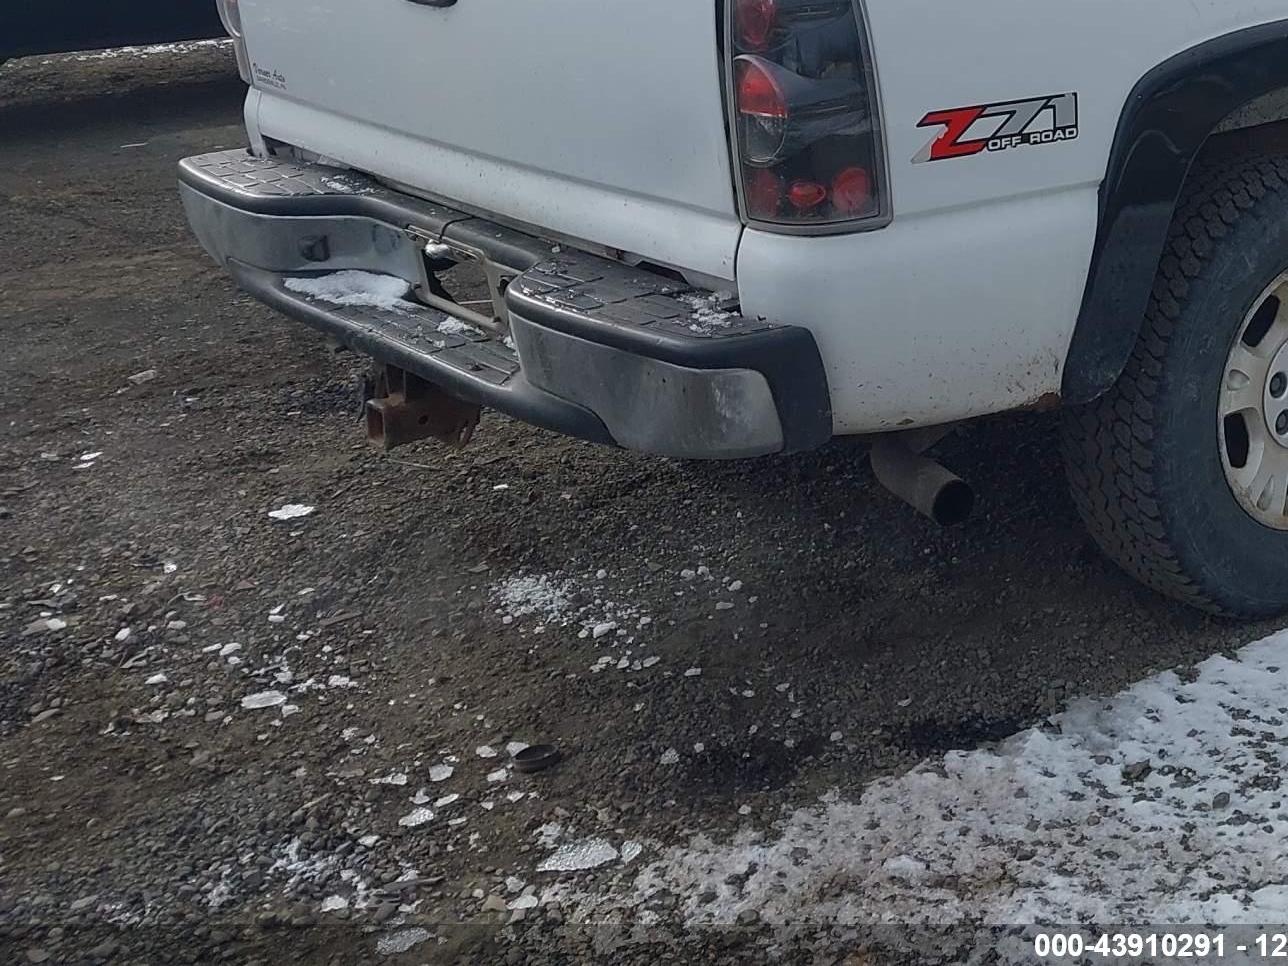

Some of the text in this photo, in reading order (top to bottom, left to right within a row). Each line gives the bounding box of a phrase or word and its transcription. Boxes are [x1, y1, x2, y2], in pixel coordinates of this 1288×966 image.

[911, 91, 1078, 164] Z71
[987, 127, 1078, 151] OFF ROAD
